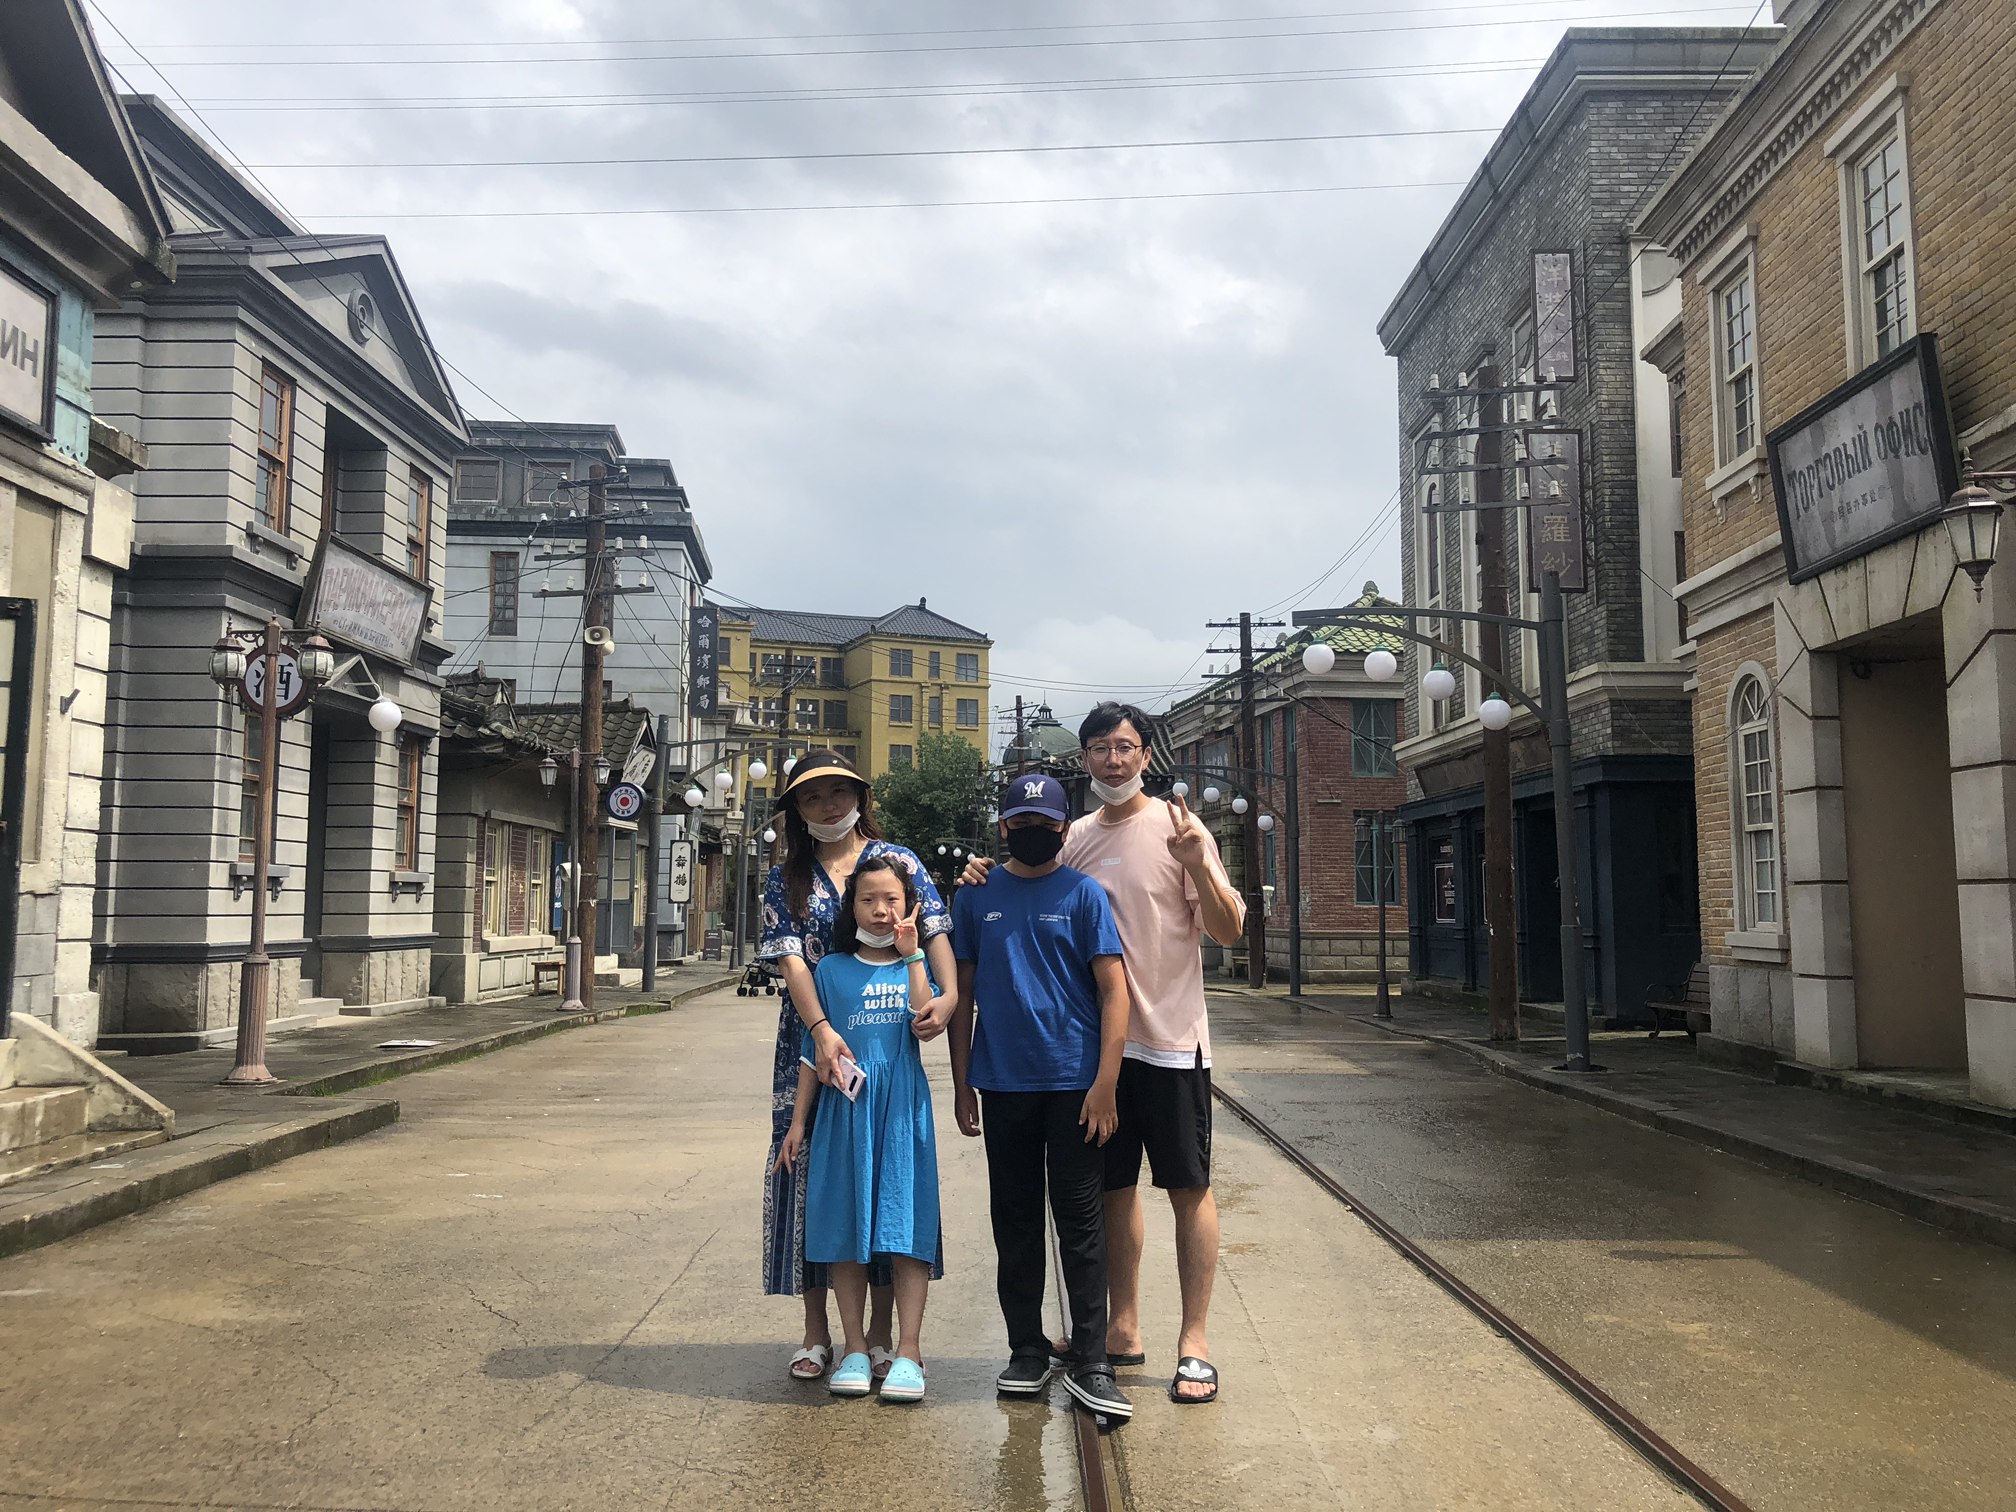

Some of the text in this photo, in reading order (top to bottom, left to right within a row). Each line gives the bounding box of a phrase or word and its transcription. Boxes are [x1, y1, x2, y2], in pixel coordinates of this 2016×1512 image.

[1787, 402, 1929, 520] ТОРГОВЫЙ ОФИС
[1024, 781, 1046, 798] M
[861, 982, 907, 996] Alive
[864, 994, 904, 1010] with
